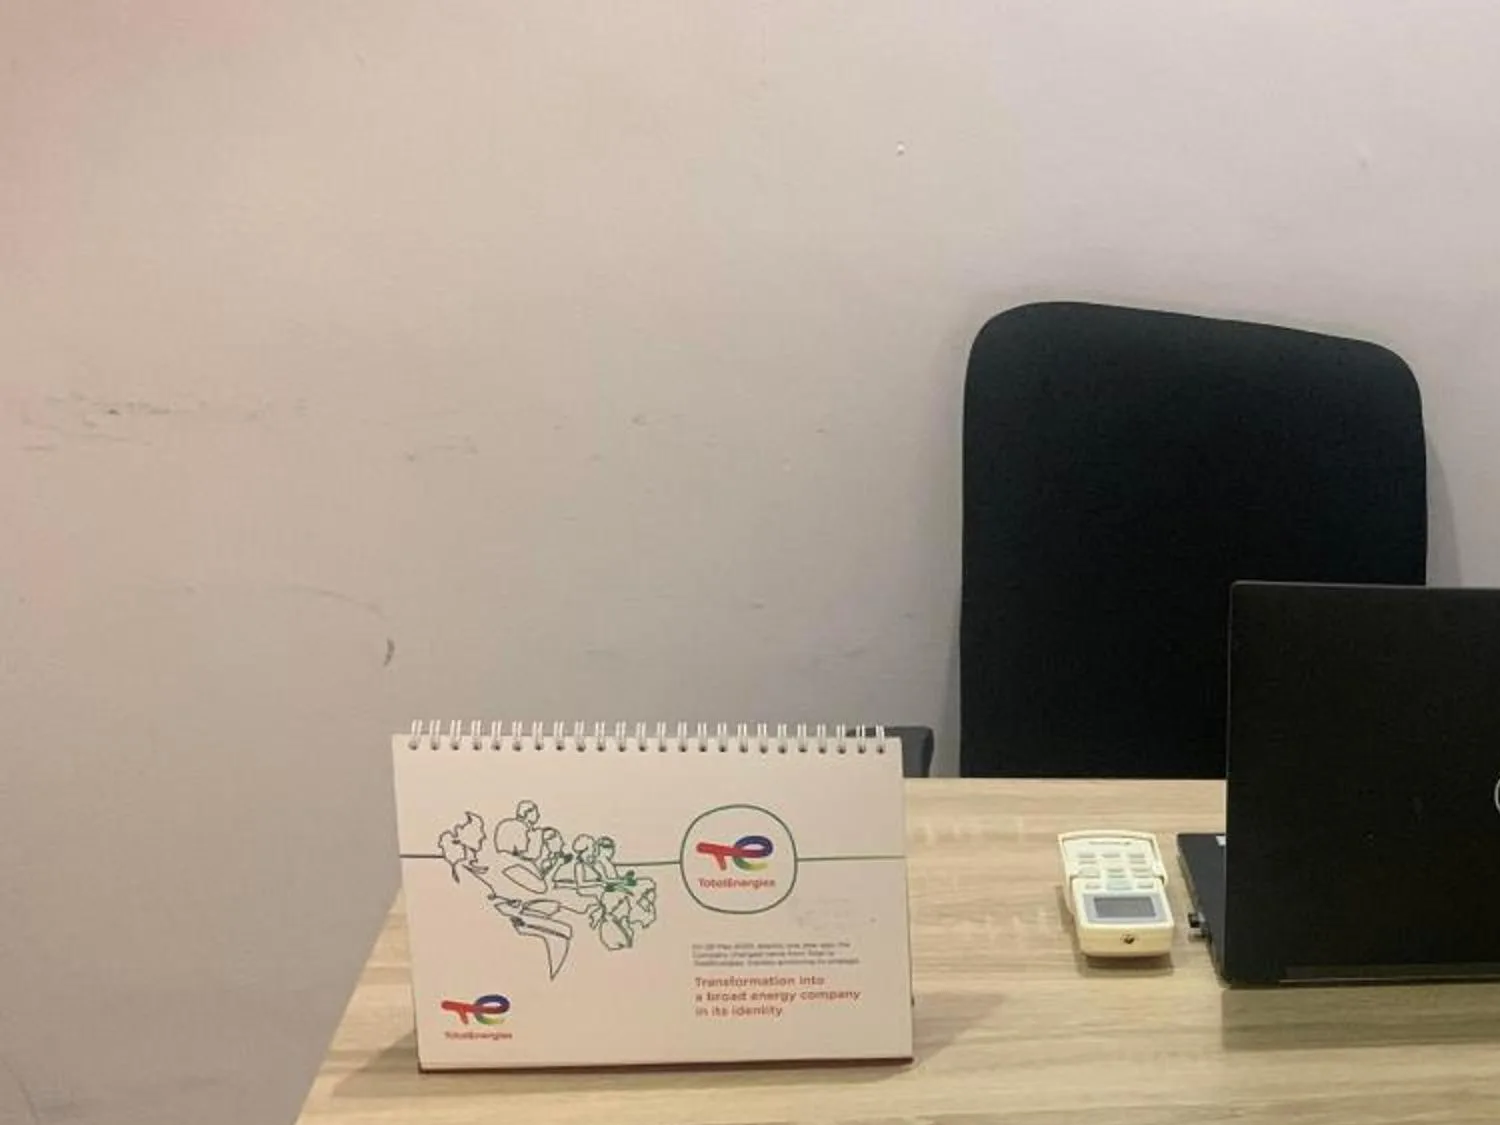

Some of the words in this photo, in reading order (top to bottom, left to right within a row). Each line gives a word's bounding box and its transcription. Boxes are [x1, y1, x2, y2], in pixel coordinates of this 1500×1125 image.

[698, 878, 776, 890] TotalEnergies
[694, 975, 796, 988] Transformation
[695, 993, 703, 1001] a
[706, 991, 748, 1001] broad
[751, 991, 797, 1003] energy
[799, 990, 862, 1002] company
[695, 1004, 709, 1016] in
[711, 1004, 729, 1016] its
[731, 1004, 784, 1017] identity
